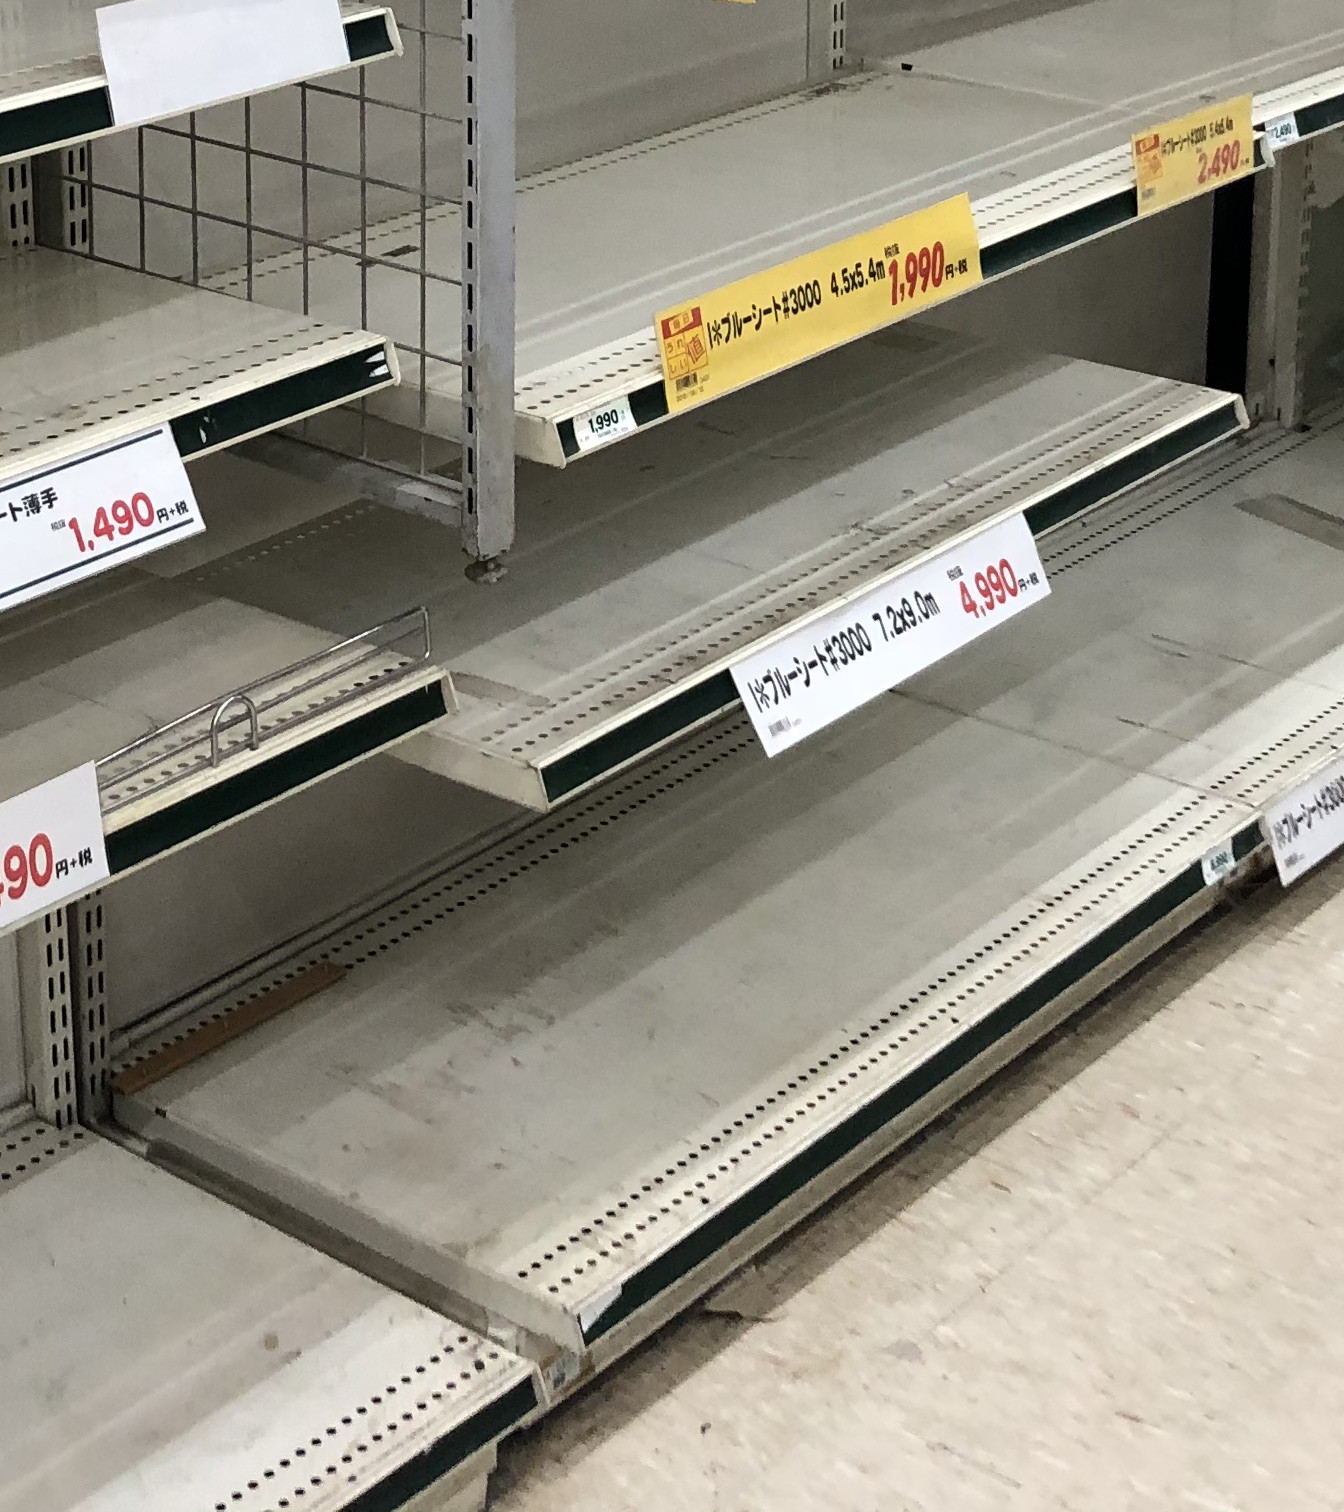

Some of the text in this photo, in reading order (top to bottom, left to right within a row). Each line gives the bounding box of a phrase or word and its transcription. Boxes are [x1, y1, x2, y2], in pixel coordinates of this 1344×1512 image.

[1198, 139, 1241, 185] 2,490
[829, 256, 886, 298] 4.5x5.4m
[888, 240, 945, 306] 1,990
[587, 408, 619, 435] 1,990
[68, 491, 155, 553] 1,490
[958, 557, 1019, 619] 4,990
[872, 589, 942, 643] 7.2x9.0m
[54, 846, 94, 879] 円+税
